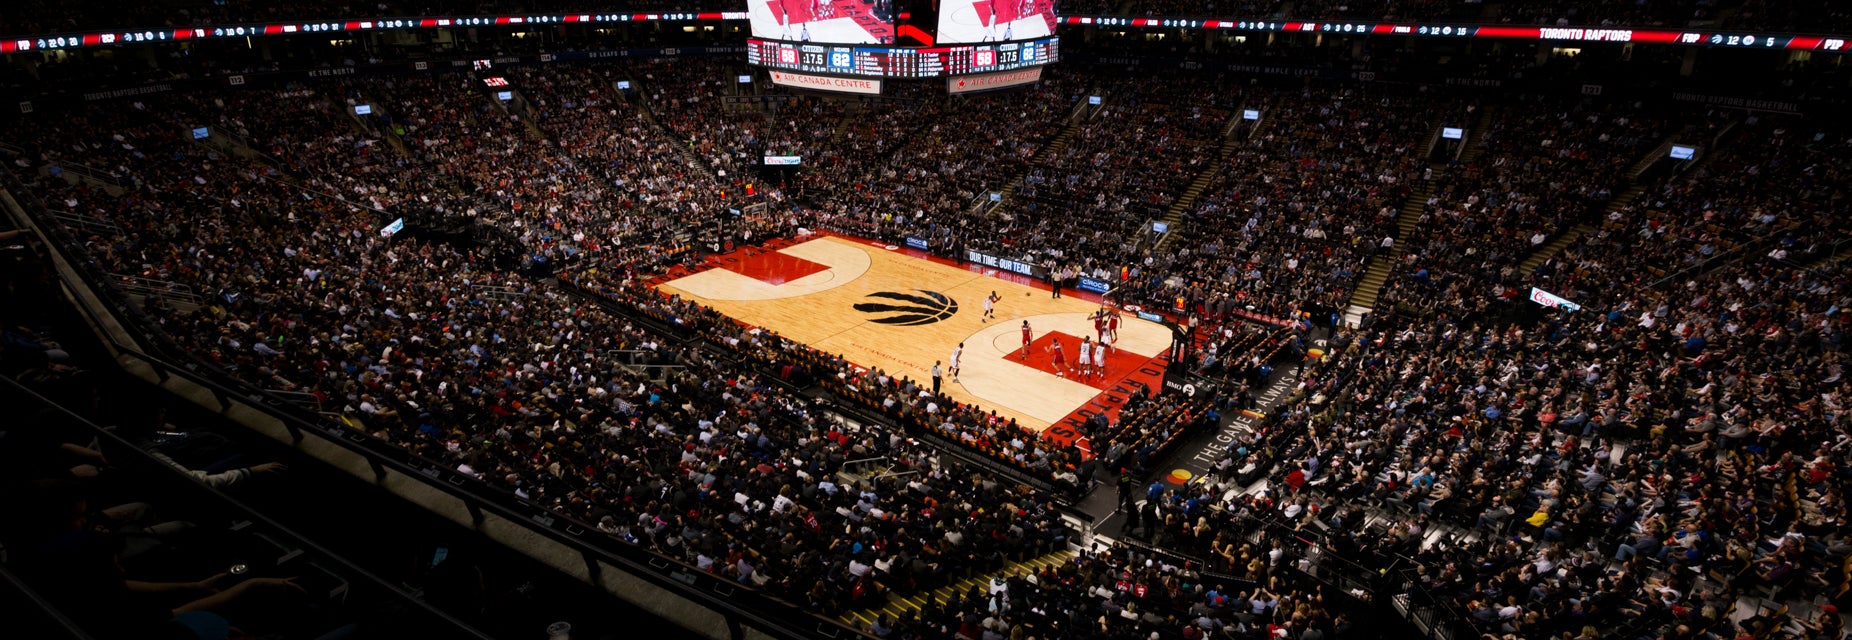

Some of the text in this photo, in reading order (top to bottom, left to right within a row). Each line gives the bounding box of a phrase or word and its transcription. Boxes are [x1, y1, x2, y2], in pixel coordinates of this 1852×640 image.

[226, 27, 235, 36] 10
[250, 27, 255, 35] 7
[1335, 24, 1341, 32] 3
[1431, 27, 1440, 35] 12
[1457, 28, 1467, 36] 15
[1539, 28, 1633, 41] TORONTO RAPTORS
[1681, 33, 1775, 46] FBP 12 5
[1823, 39, 1844, 50] PIP
[801, 45, 824, 53] CITIZEN
[1023, 47, 1034, 60] 82
[781, 50, 795, 63] 58
[832, 53, 850, 67] 82
[976, 51, 992, 66] 58
[308, 67, 355, 78] WE THE NORTH
[971, 70, 1040, 86] AIR CANADA CENTRE
[230, 75, 244, 85] 112
[798, 76, 832, 86] CANADA
[834, 79, 872, 90] CENTRE
[1456, 78, 1471, 86] THE
[1472, 79, 1502, 87] NORTH
[84, 91, 112, 101] TORONTO
[1672, 91, 1801, 112] TORONTO RAPTORS BASKETBALL
[969, 251, 1032, 276] OUR TIME. OUR TEAM.
[863, 347, 896, 361] CANADA
[1166, 380, 1182, 391] BMO
[1051, 378, 1143, 439] RAPTORS
[1193, 442, 1222, 463] THE
[1217, 416, 1253, 444] GAME
[1256, 376, 1296, 408] ALWAYS
